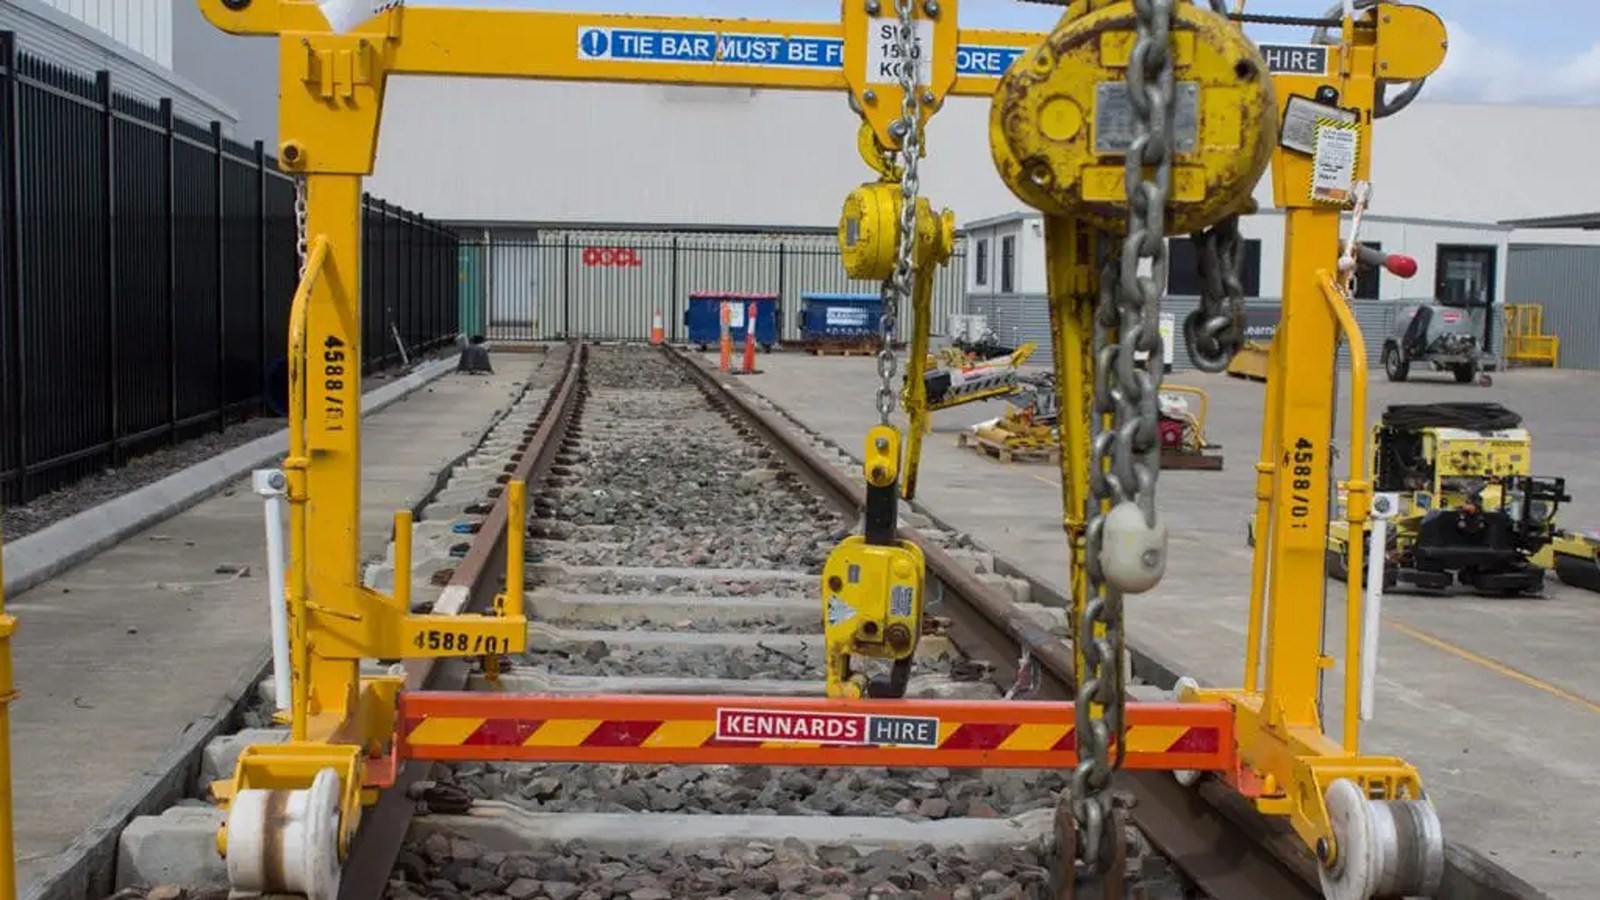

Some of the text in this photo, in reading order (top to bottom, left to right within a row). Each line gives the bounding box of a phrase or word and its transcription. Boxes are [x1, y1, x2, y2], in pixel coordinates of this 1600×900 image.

[619, 35, 654, 55] TIE
[661, 37, 710, 57] BAR
[717, 39, 781, 60] MUST
[787, 43, 819, 62] BE
[957, 51, 1001, 71] ORE
[880, 43, 921, 59] 150
[1266, 49, 1318, 70] HIRE
[1291, 437, 1313, 528] 4588/01
[413, 630, 510, 654] 4588/01
[726, 714, 930, 742] KENNARDS HIRE
